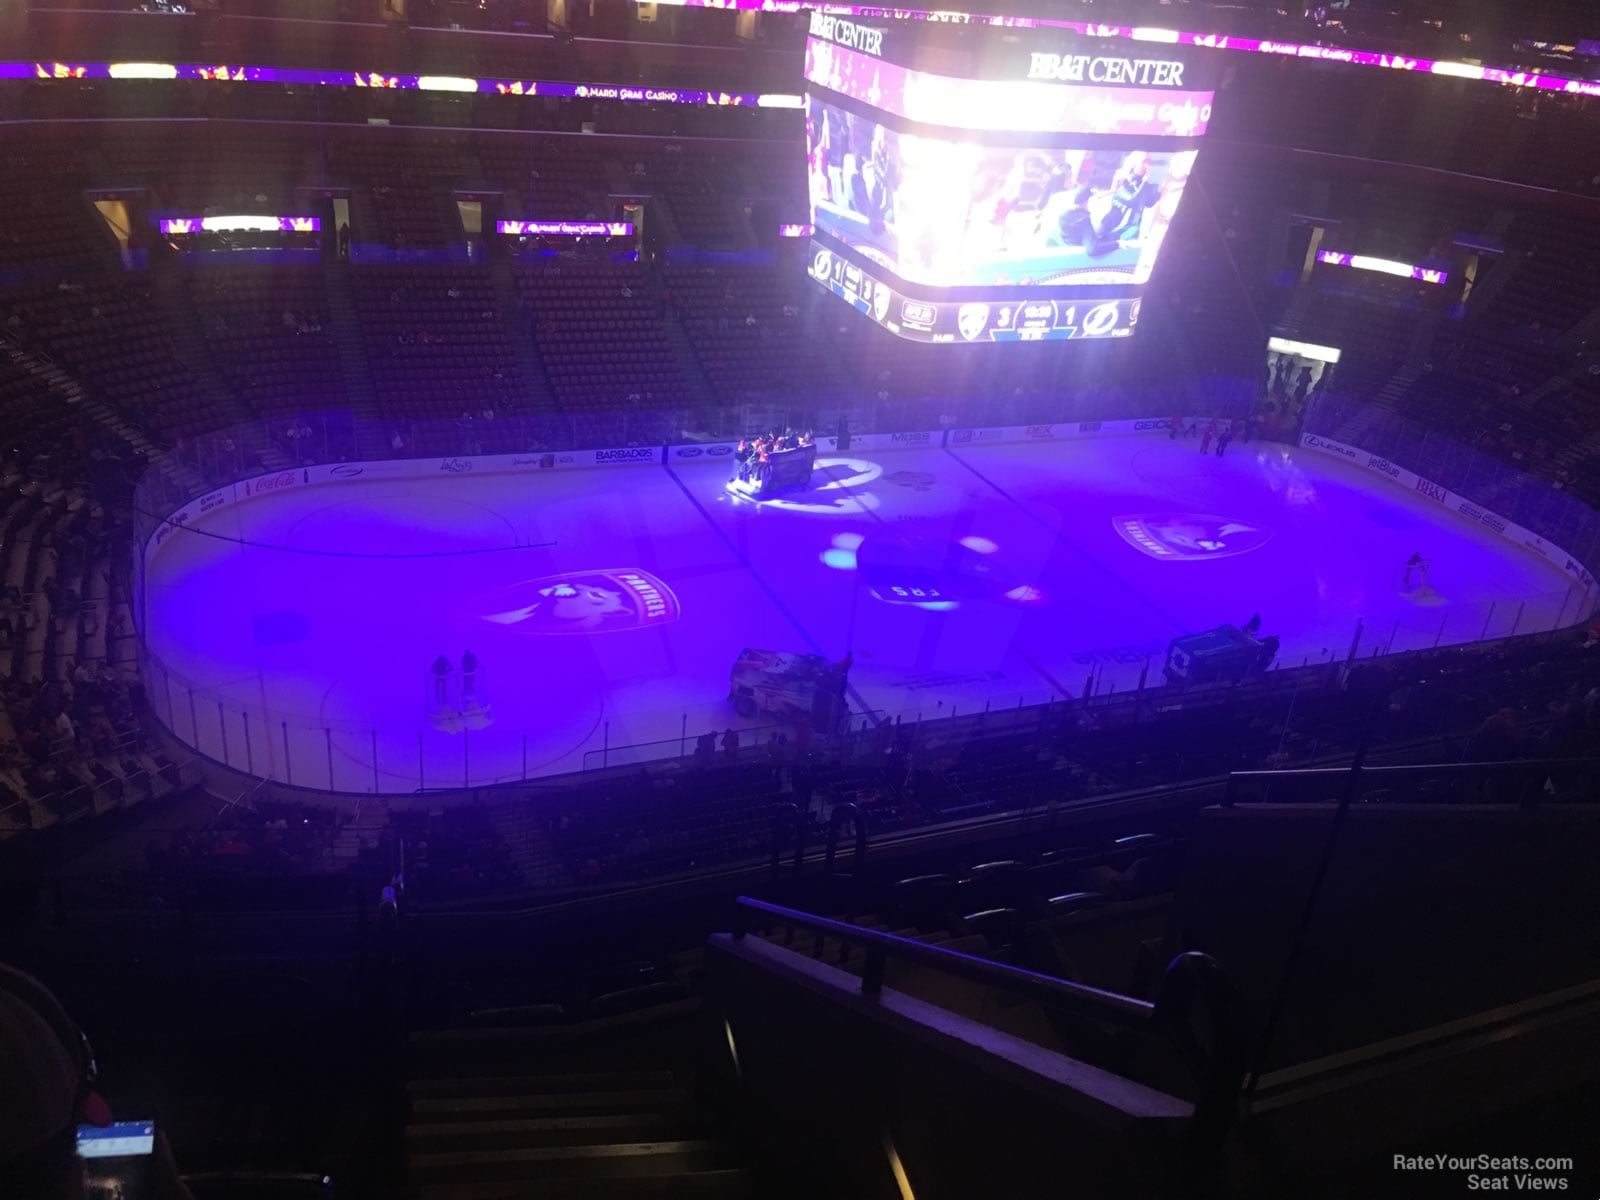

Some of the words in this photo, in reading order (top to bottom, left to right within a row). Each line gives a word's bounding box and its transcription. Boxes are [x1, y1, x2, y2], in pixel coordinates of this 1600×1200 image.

[835, 19, 882, 56] CENTER
[1027, 53, 1090, 80] BB&T
[1088, 57, 1184, 86] CENTER
[998, 307, 1011, 327] 3
[1065, 306, 1076, 325] 1
[595, 449, 653, 459] BARBADOS
[1320, 441, 1356, 458] LEXUS
